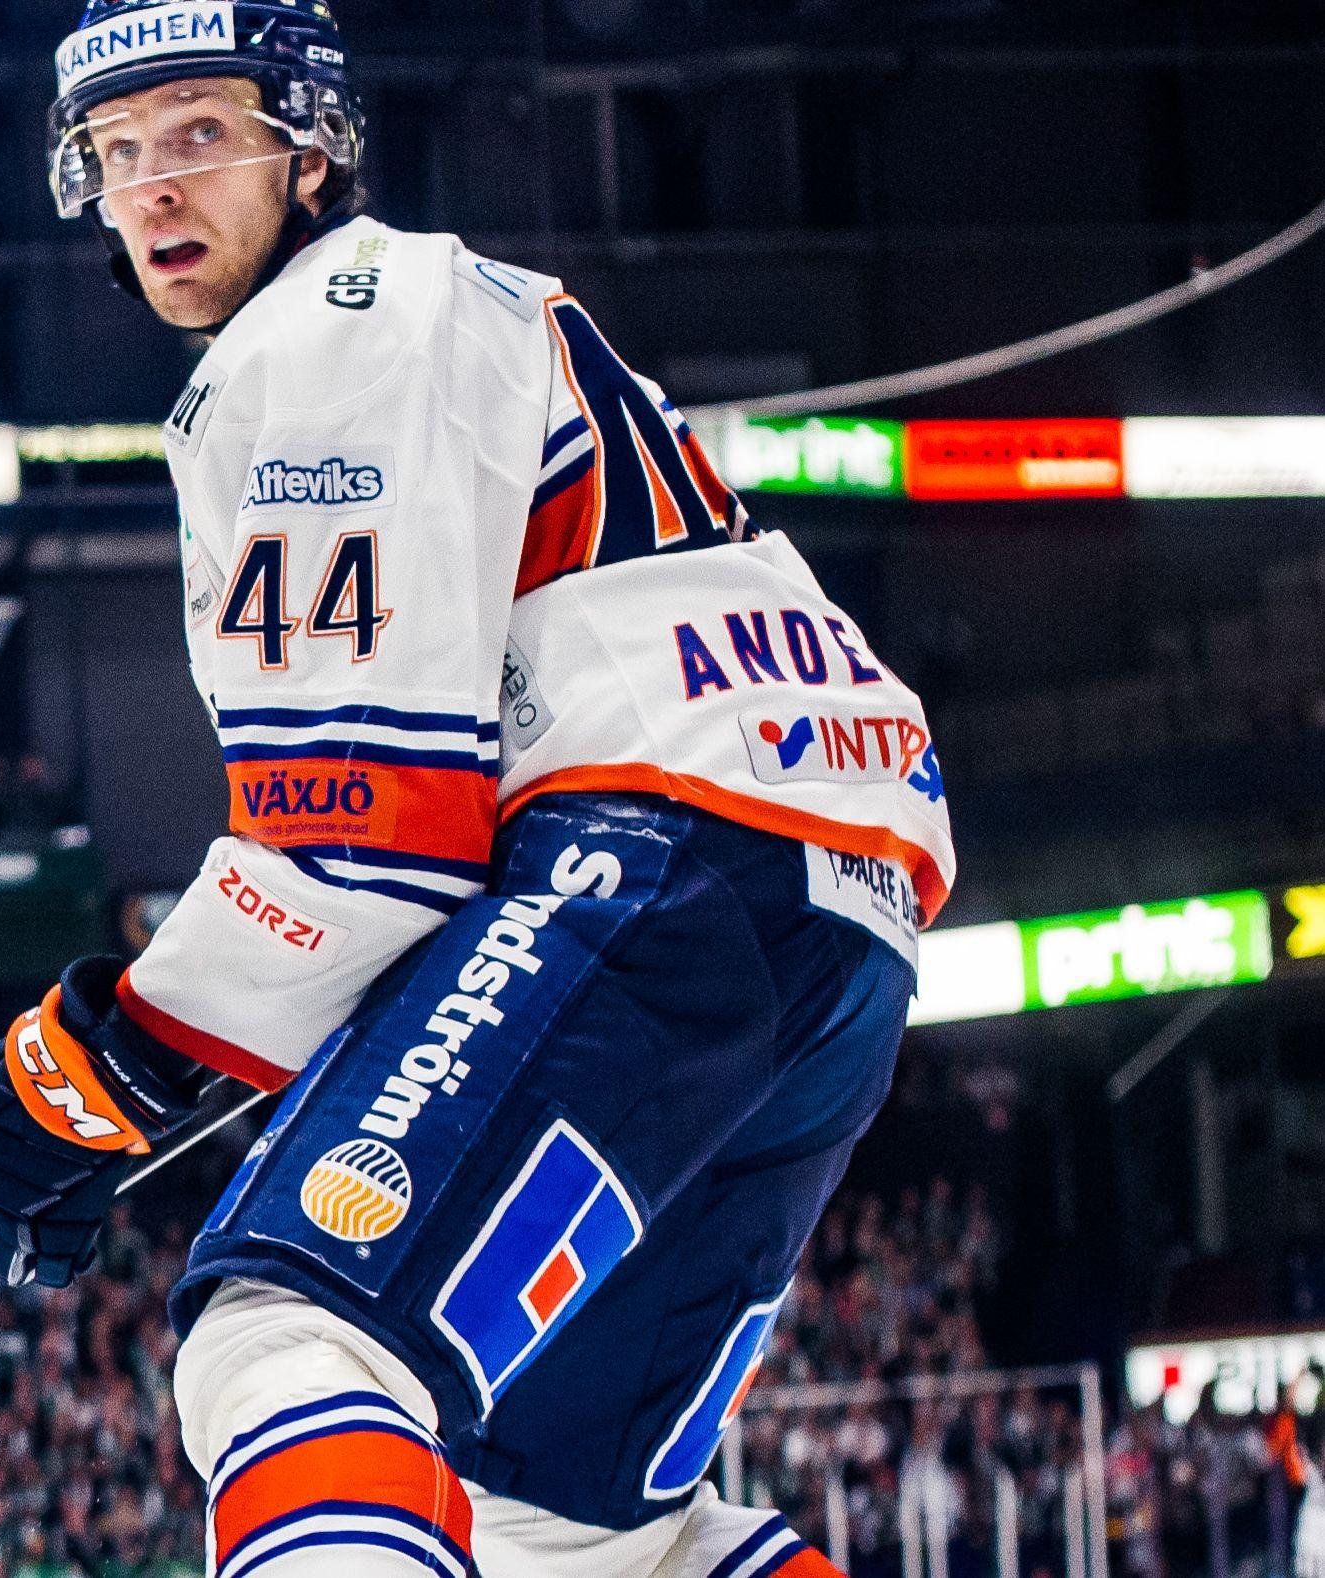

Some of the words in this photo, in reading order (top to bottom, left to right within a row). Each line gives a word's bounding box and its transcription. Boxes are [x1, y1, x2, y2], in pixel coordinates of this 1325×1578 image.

[306, 44, 344, 65] CCM
[172, 381, 211, 436] ut
[242, 457, 383, 510] Atteviks
[216, 529, 393, 670] 44
[673, 609, 887, 702] ANDE
[241, 770, 374, 818] VÄXJÖ
[218, 866, 325, 951] ZORZI
[358, 842, 622, 1139] Sndström
[1037, 900, 1236, 1006] print
